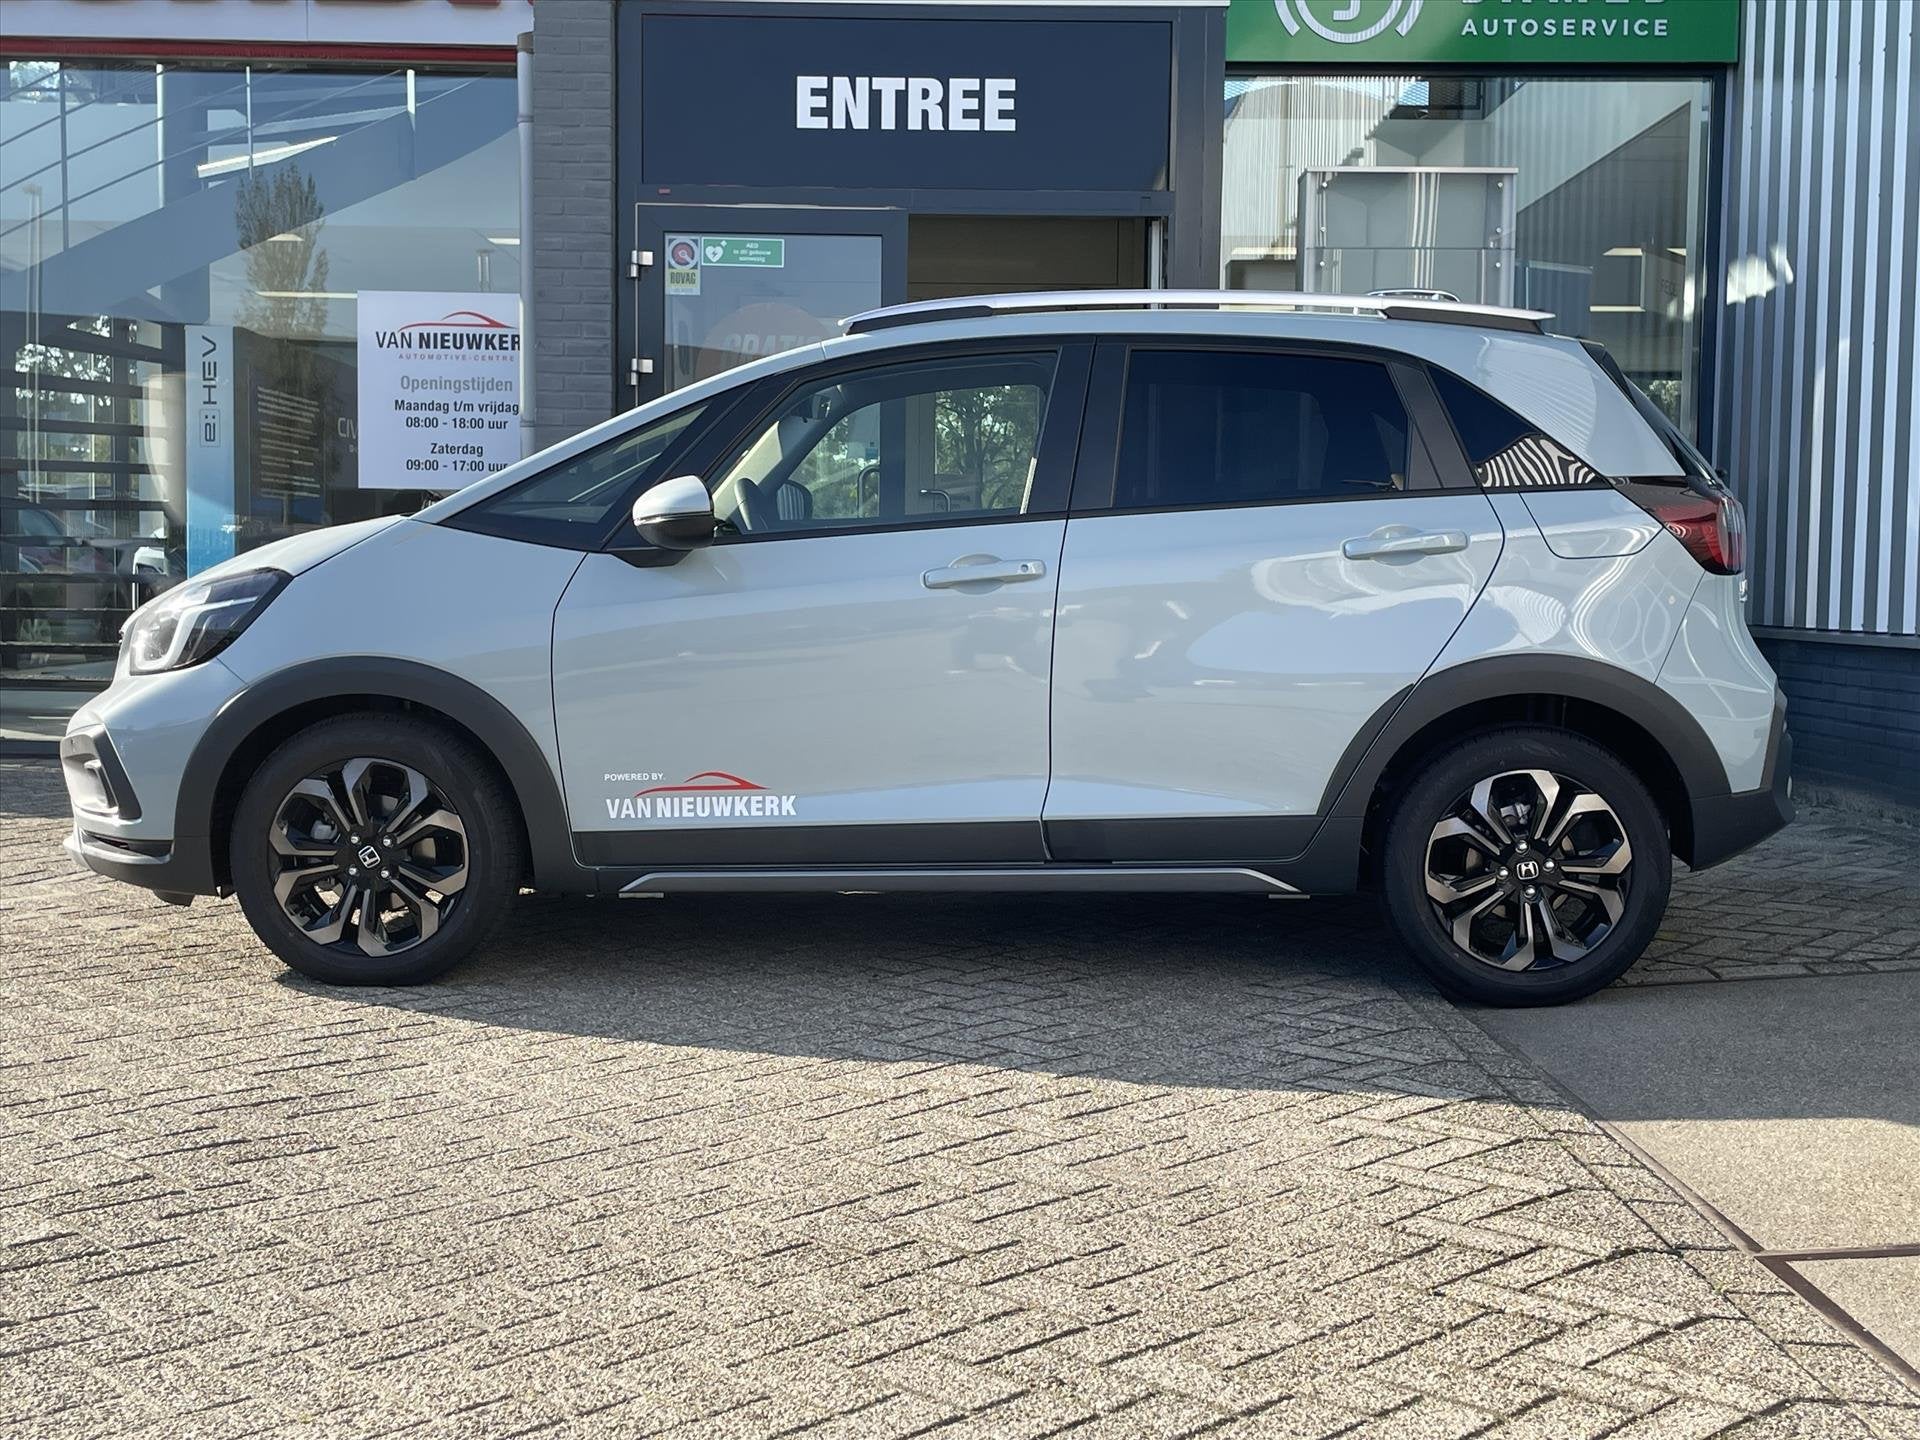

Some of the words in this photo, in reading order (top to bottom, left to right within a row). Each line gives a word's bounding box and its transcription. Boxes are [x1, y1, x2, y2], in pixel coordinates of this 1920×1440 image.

[1461, 18, 1668, 37] AUTOSERVICE
[796, 76, 1017, 132] ENTREE
[670, 272, 696, 284] BOVAG
[375, 331, 412, 349] VAN
[418, 333, 520, 351] NIEUWKER
[400, 375, 513, 394] Openingstijden
[394, 400, 450, 414] Maandag
[453, 401, 475, 412] t/m
[478, 402, 520, 416] vrijdag
[337, 417, 357, 439] CIV
[405, 416, 439, 429] 08:00
[452, 418, 485, 430] 18:00
[488, 420, 509, 430] uur
[430, 443, 484, 457] Zaterdag
[406, 459, 439, 472] 09:00
[452, 460, 485, 472] 17:00
[488, 463, 508, 472] uur
[604, 773, 650, 782] POWERED
[606, 798, 652, 819] VAN
[656, 795, 797, 818] NIEUWKERK
